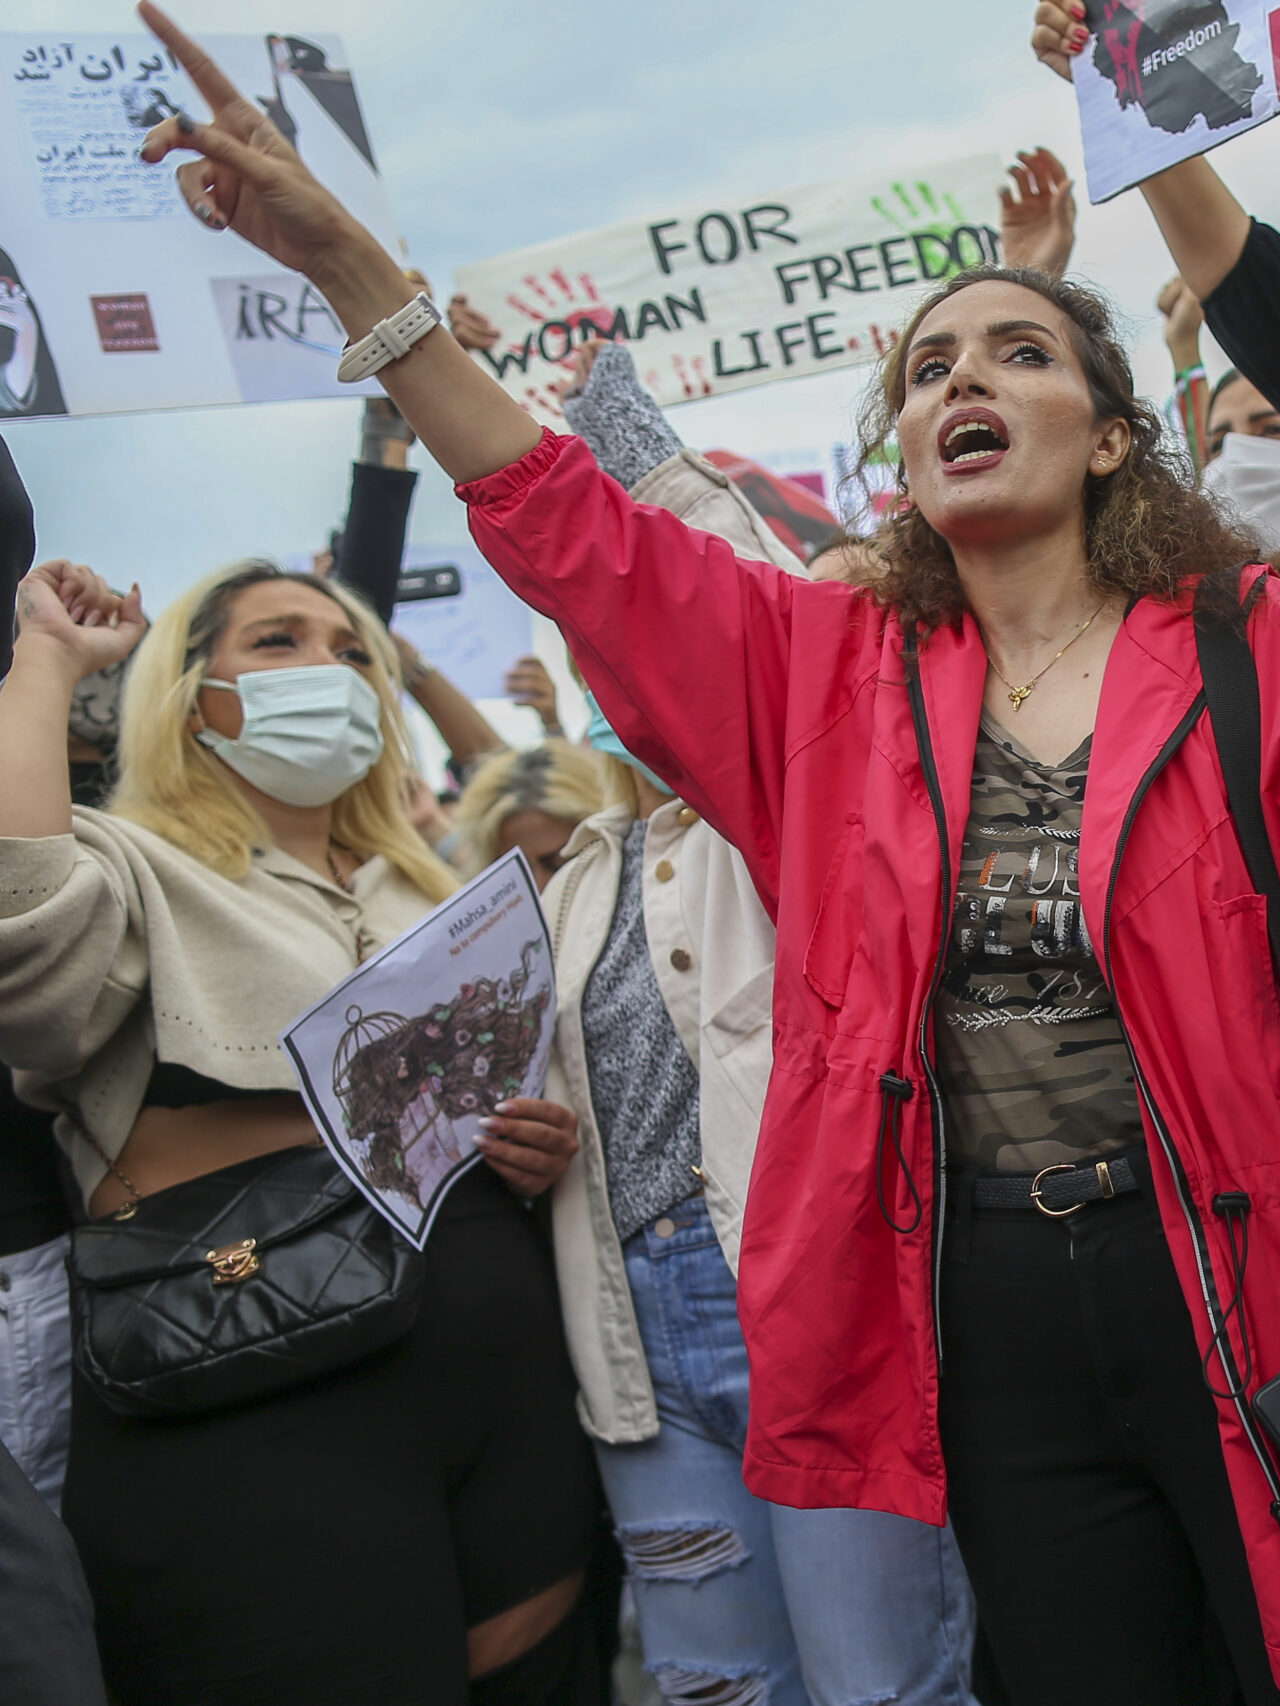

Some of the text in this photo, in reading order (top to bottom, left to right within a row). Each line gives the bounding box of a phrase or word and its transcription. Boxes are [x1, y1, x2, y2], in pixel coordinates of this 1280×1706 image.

[1141, 20, 1222, 77] #Freedom
[648, 202, 799, 275] FOR
[236, 283, 344, 345] iRA
[481, 287, 708, 380] WOMAN
[711, 311, 845, 378] LIFE
